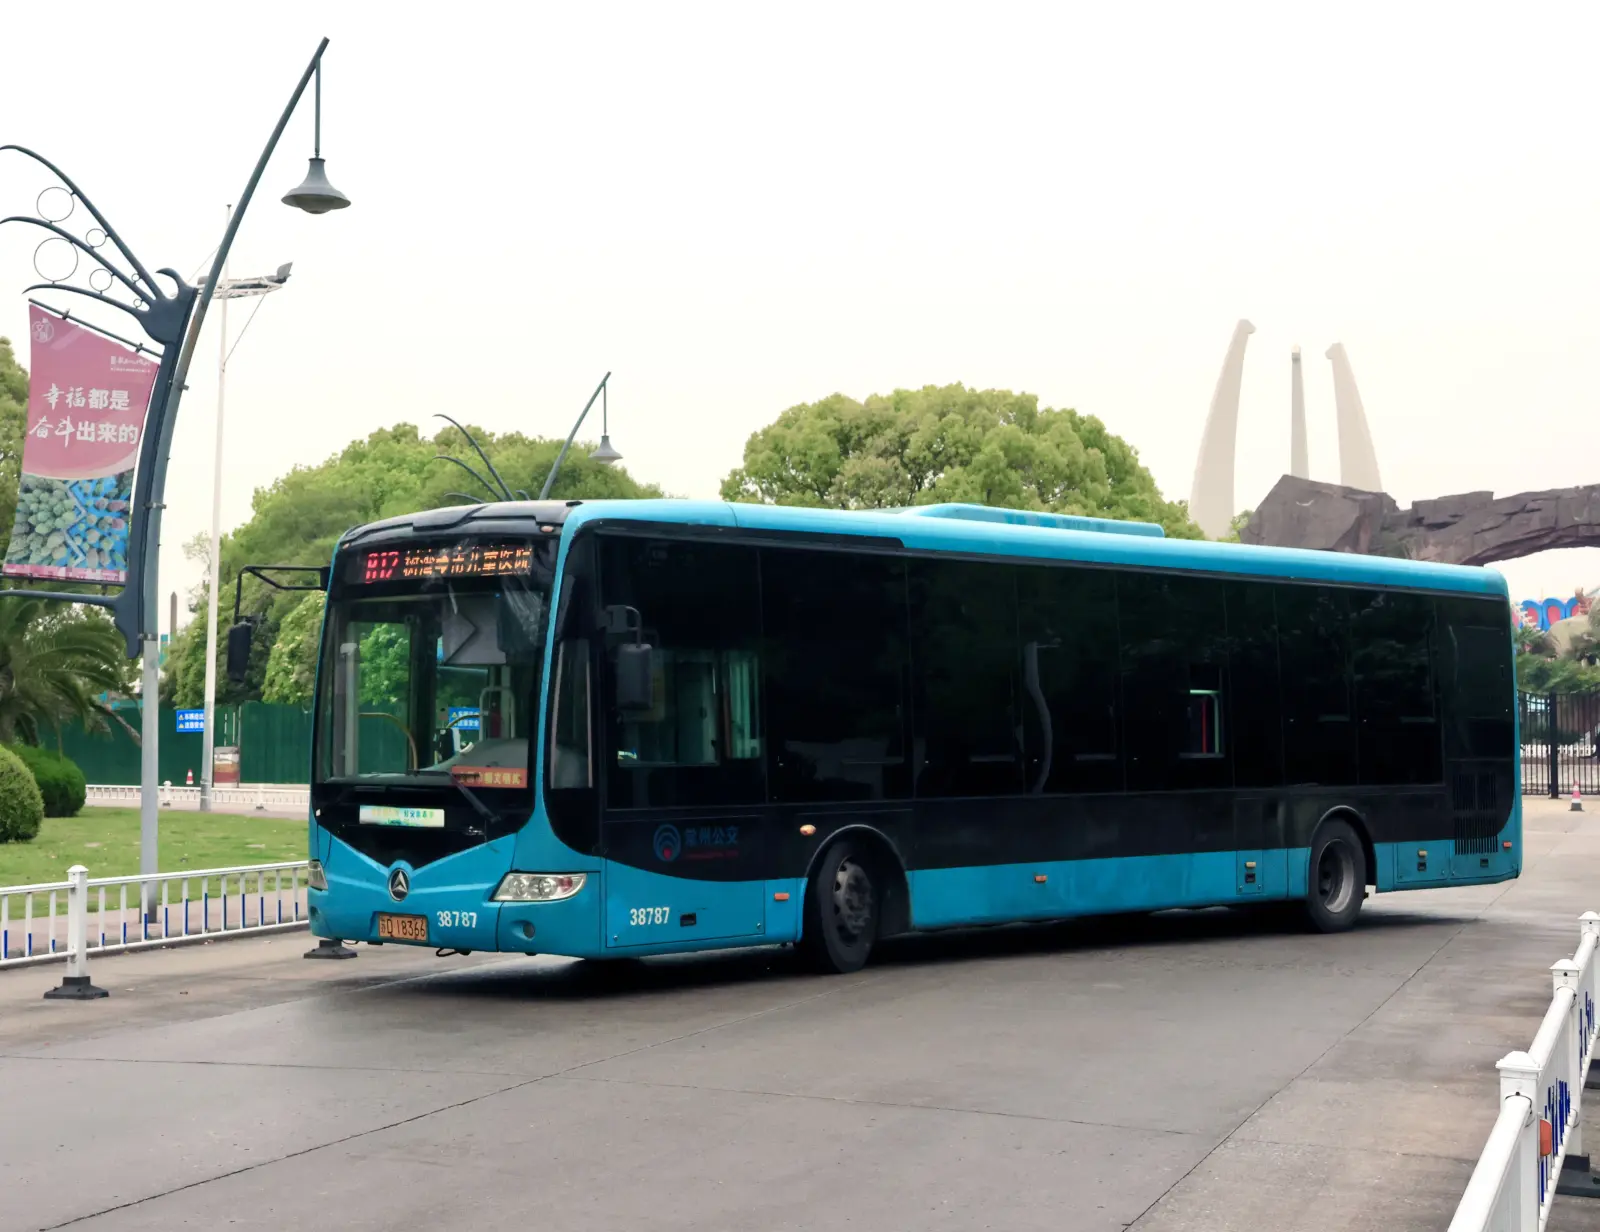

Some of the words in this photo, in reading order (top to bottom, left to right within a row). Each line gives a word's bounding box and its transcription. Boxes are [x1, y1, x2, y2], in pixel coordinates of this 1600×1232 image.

[42, 382, 130, 411] 幸福都是
[29, 415, 139, 448] 奋斗出来的
[436, 910, 477, 928] 38787
[629, 906, 670, 926] 38787
